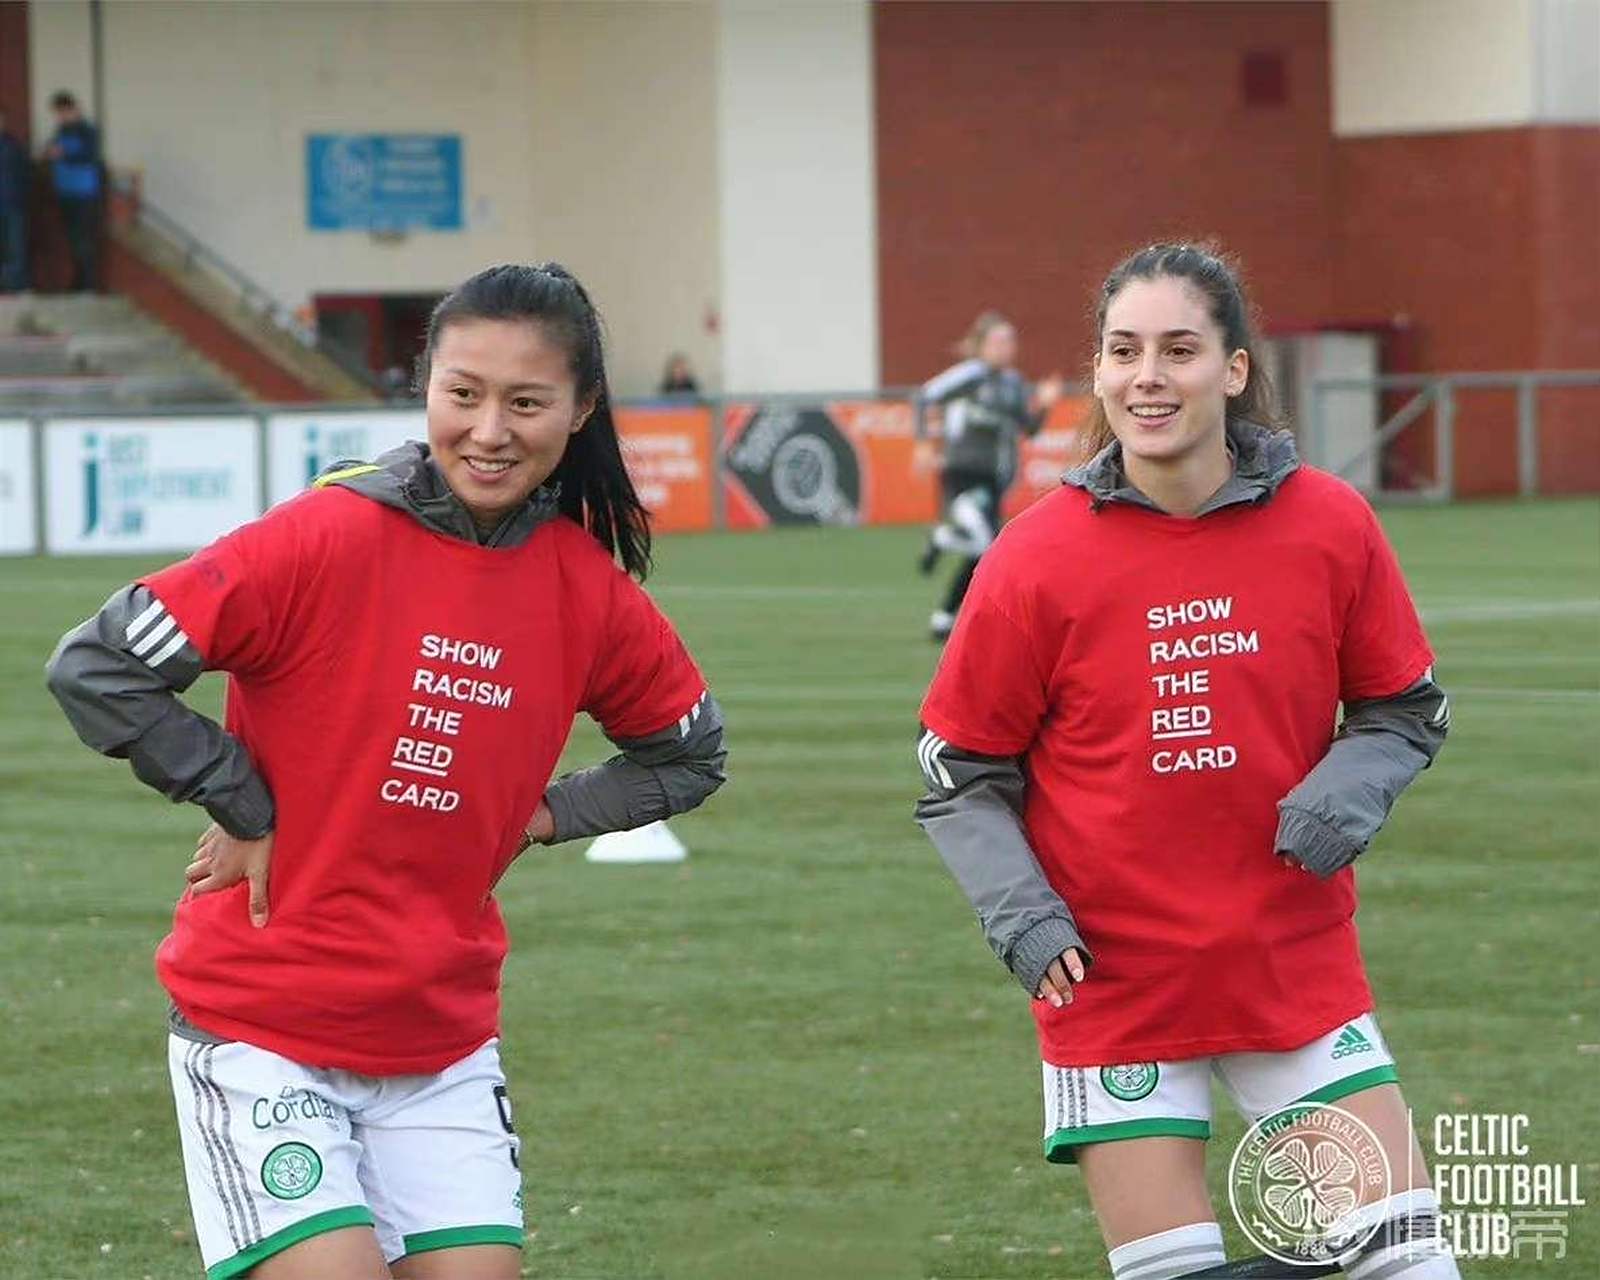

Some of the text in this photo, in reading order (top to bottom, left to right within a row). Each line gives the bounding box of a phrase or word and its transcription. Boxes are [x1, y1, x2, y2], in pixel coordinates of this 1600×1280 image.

[1147, 597, 1232, 629] SHOW
[420, 634, 502, 670] SHOW
[1150, 630, 1259, 663] RACISM
[412, 669, 513, 708] RACISM
[1152, 670, 1209, 697] THE
[408, 703, 463, 735] THE
[1152, 705, 1211, 732] RED
[393, 736, 453, 768] RED
[1152, 746, 1237, 772] CARD
[381, 780, 460, 811] CARD
